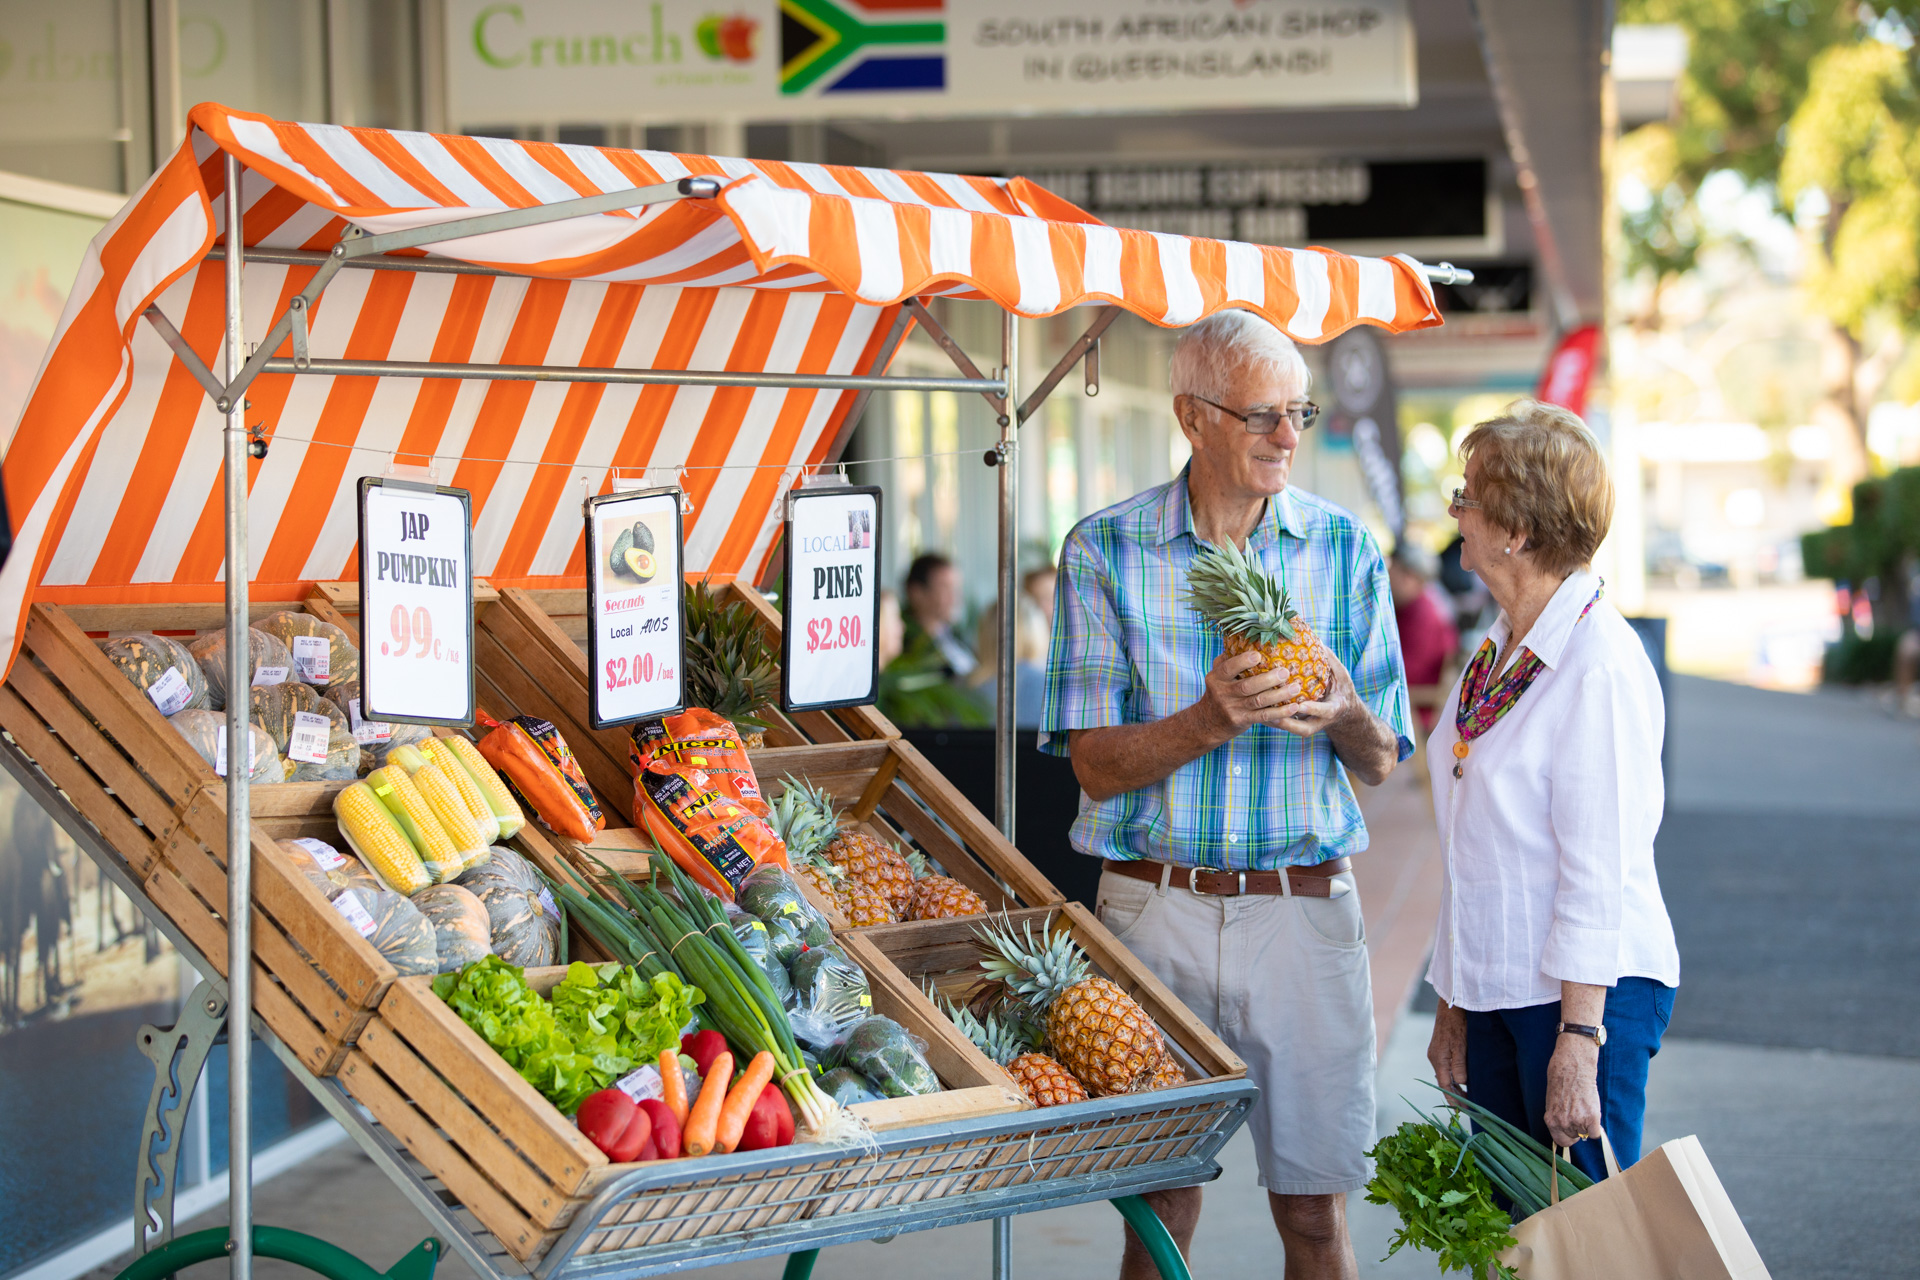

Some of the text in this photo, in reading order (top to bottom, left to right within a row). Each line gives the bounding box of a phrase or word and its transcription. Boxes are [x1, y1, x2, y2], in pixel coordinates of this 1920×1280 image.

[471, 2, 682, 69] Crunch
[974, 8, 1382, 47] SOUTH AFRICAN SHOP
[1024, 55, 1063, 83] IN
[400, 511, 430, 542] JAP
[803, 534, 850, 554] LOCAL
[377, 551, 458, 588] PUMPKIN
[813, 563, 863, 600] PINES
[604, 594, 646, 613] Seconds
[610, 616, 670, 640] Local AVOS
[605, 652, 654, 692] $2.00
[659, 740, 736, 756] NICOL
[703, 828, 732, 850] CARROT
[725, 857, 751, 878] 1kg NET
